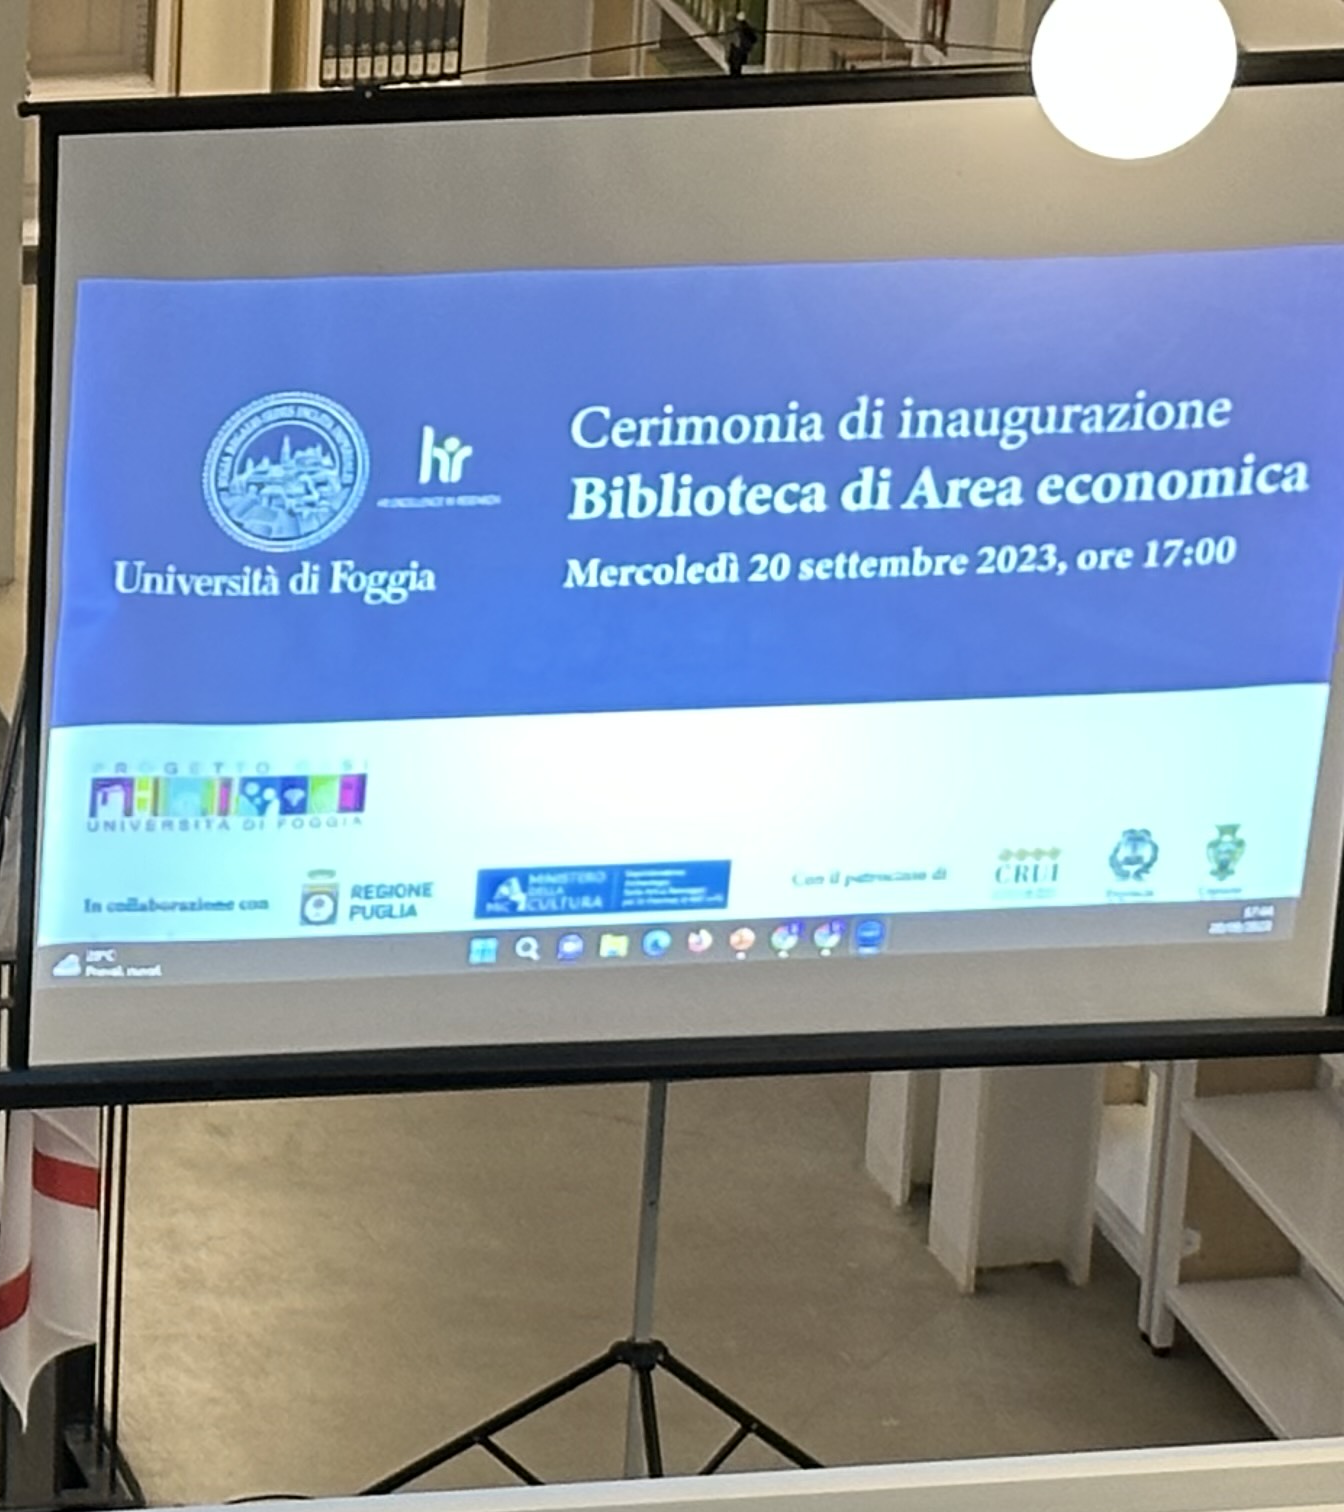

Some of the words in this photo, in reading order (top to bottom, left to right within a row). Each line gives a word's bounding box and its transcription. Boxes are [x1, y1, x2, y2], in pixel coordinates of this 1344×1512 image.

[570, 400, 824, 449] Cerimonia
[838, 394, 885, 441] di
[897, 389, 1233, 451] inaugurazione
[567, 472, 828, 520] Biblioteca
[840, 466, 893, 513] di
[900, 465, 1024, 511] Area
[1036, 452, 1310, 505] economica
[562, 551, 740, 589] Mercoledì
[747, 552, 791, 582] 20
[797, 546, 969, 581] settembre
[975, 543, 1068, 576] 2023,
[1076, 546, 1134, 571] ore
[1142, 535, 1238, 568] 17:00
[113, 559, 280, 597] Università
[289, 561, 320, 594] di
[330, 559, 437, 605] Foggia
[243, 816, 266, 831] DI
[277, 815, 363, 831] FOGGIA
[995, 863, 1059, 884] CRUI
[350, 881, 435, 900] REGIONE
[84, 898, 103, 913] In
[349, 903, 418, 921] PUGLIA
[527, 895, 603, 911] CULTURA
